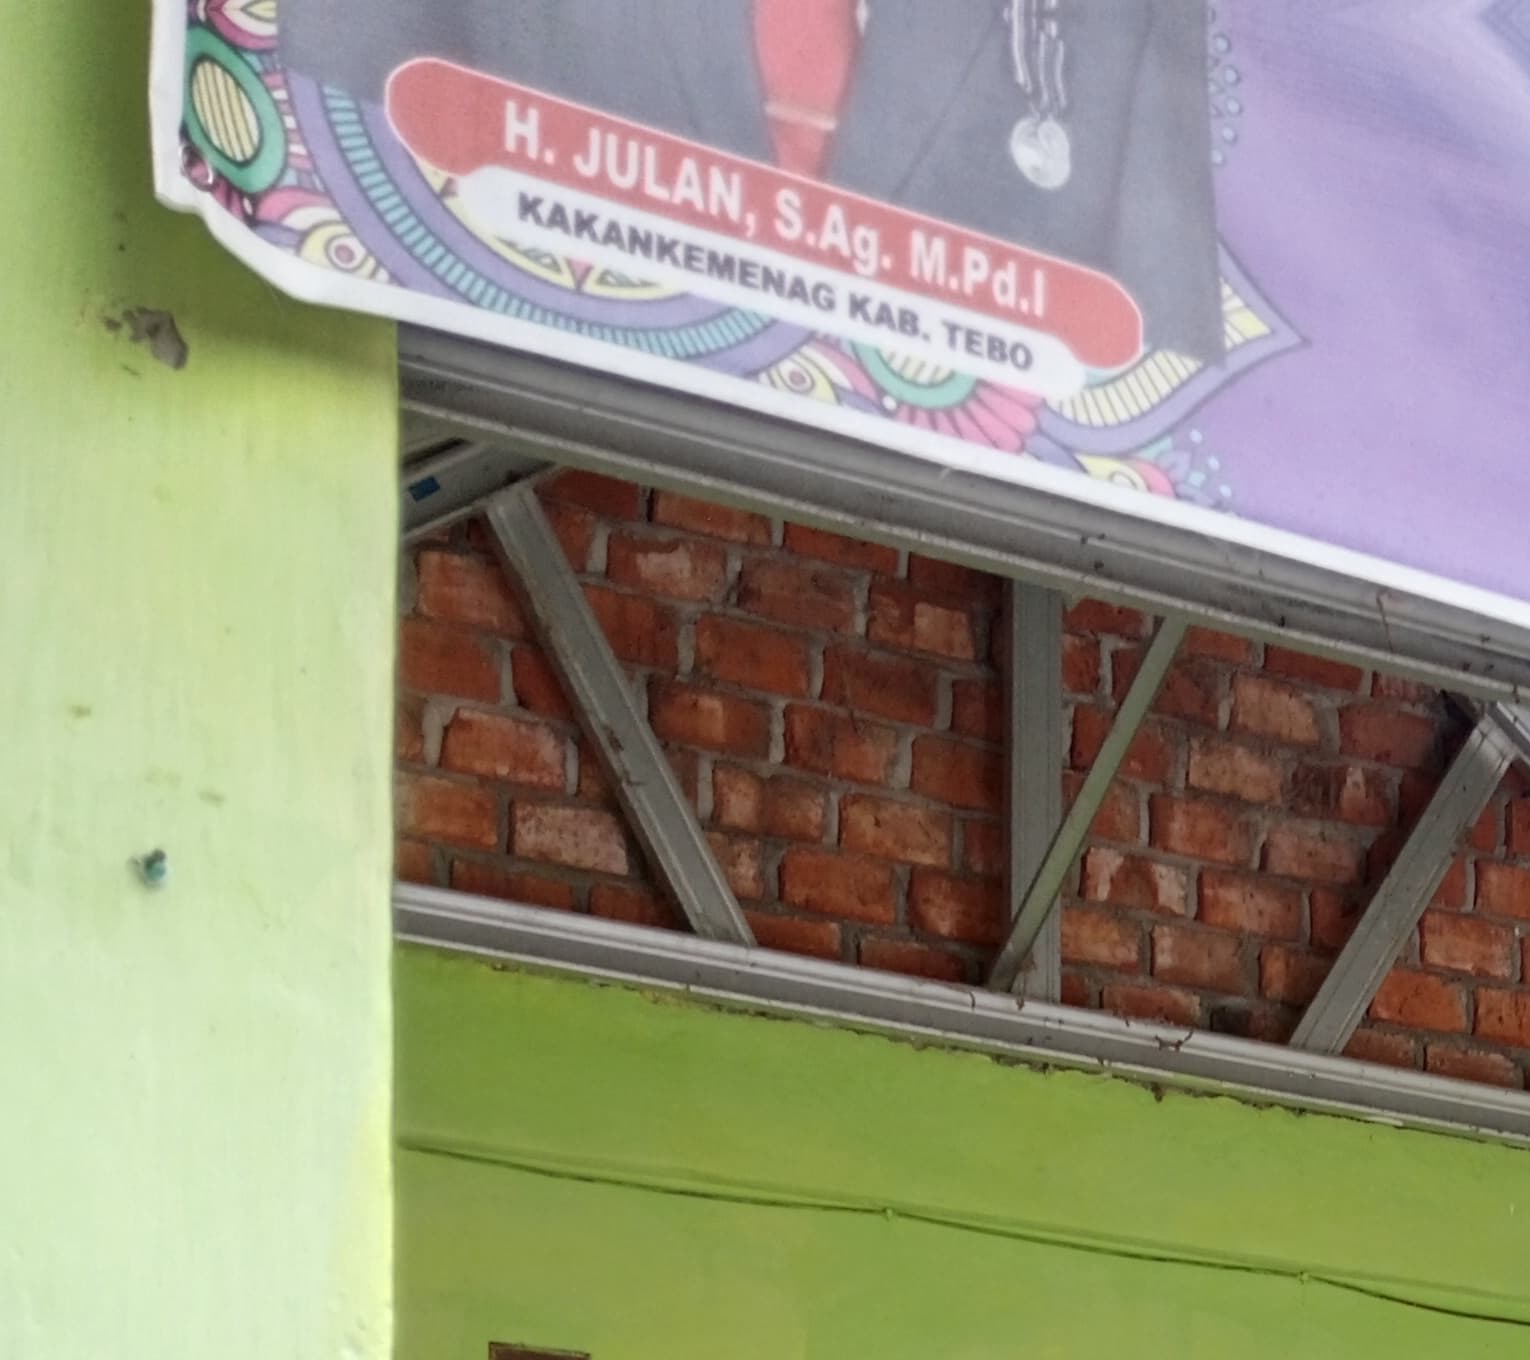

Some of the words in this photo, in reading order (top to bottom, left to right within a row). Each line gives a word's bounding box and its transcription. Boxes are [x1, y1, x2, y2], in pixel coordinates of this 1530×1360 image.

[504, 99, 556, 165] H.
[573, 127, 756, 238] JULAN,
[774, 187, 893, 276] S.Ag.
[909, 229, 1045, 318] M.Pd.I
[517, 191, 836, 312] KAKANKEMENAG
[848, 293, 931, 342] KAB.
[941, 320, 1034, 372] TEBO
